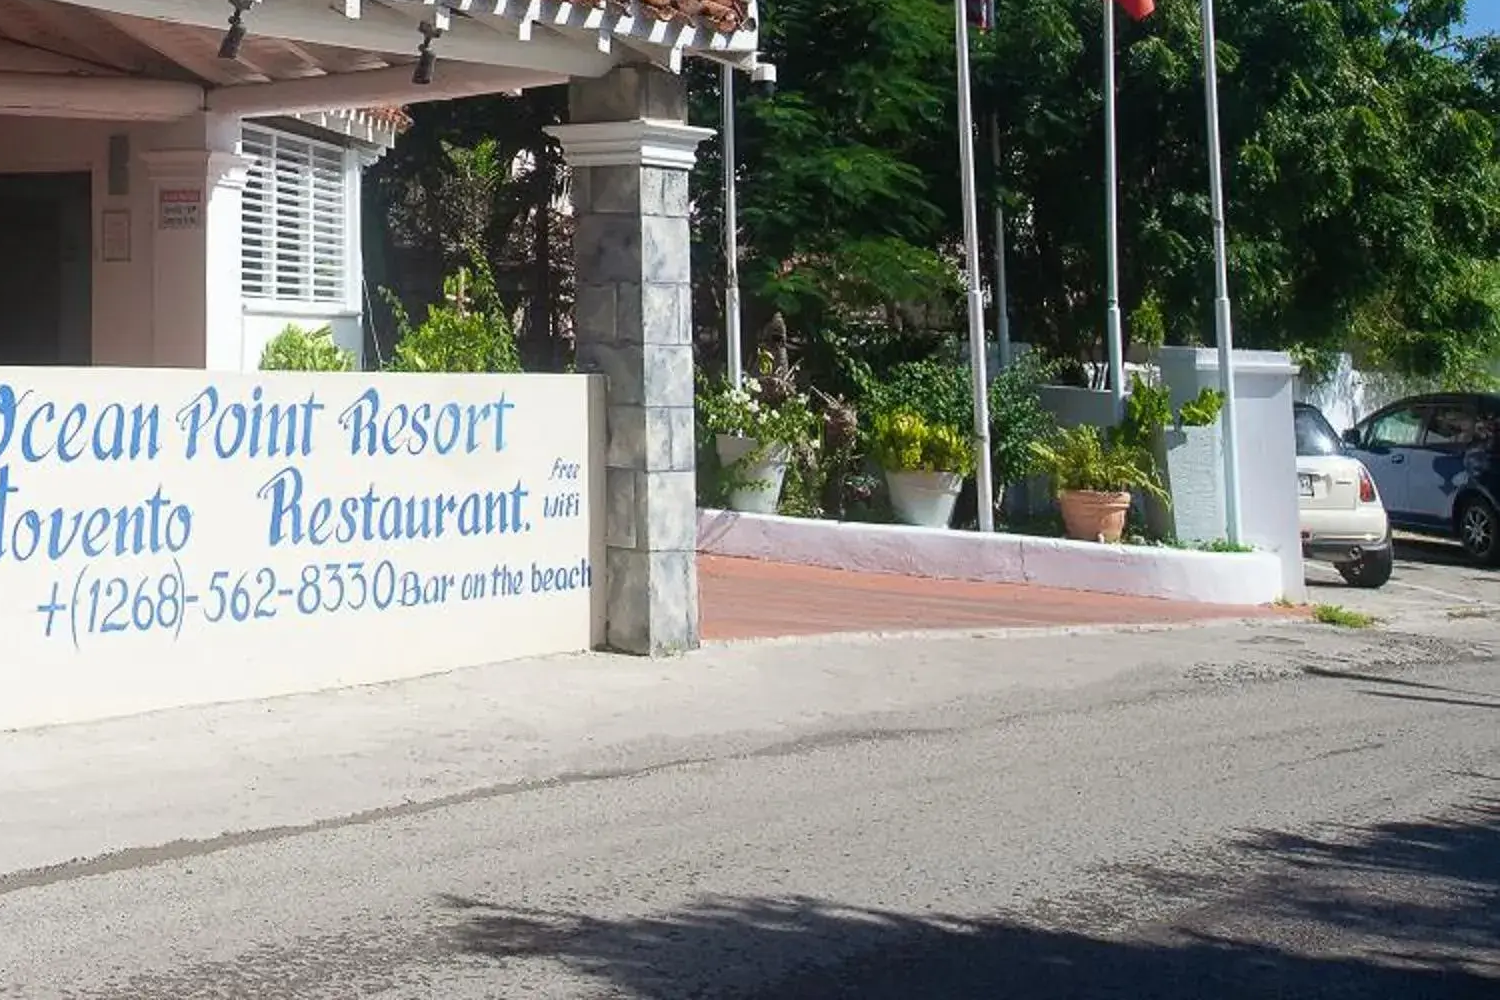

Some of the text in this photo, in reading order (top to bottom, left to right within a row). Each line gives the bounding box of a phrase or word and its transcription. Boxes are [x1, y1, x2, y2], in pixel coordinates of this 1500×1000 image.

[175, 385, 324, 460] Point
[338, 387, 515, 457] Resort
[257, 465, 531, 547] Restaurant.
[399, 557, 592, 607] Bar on the beach
